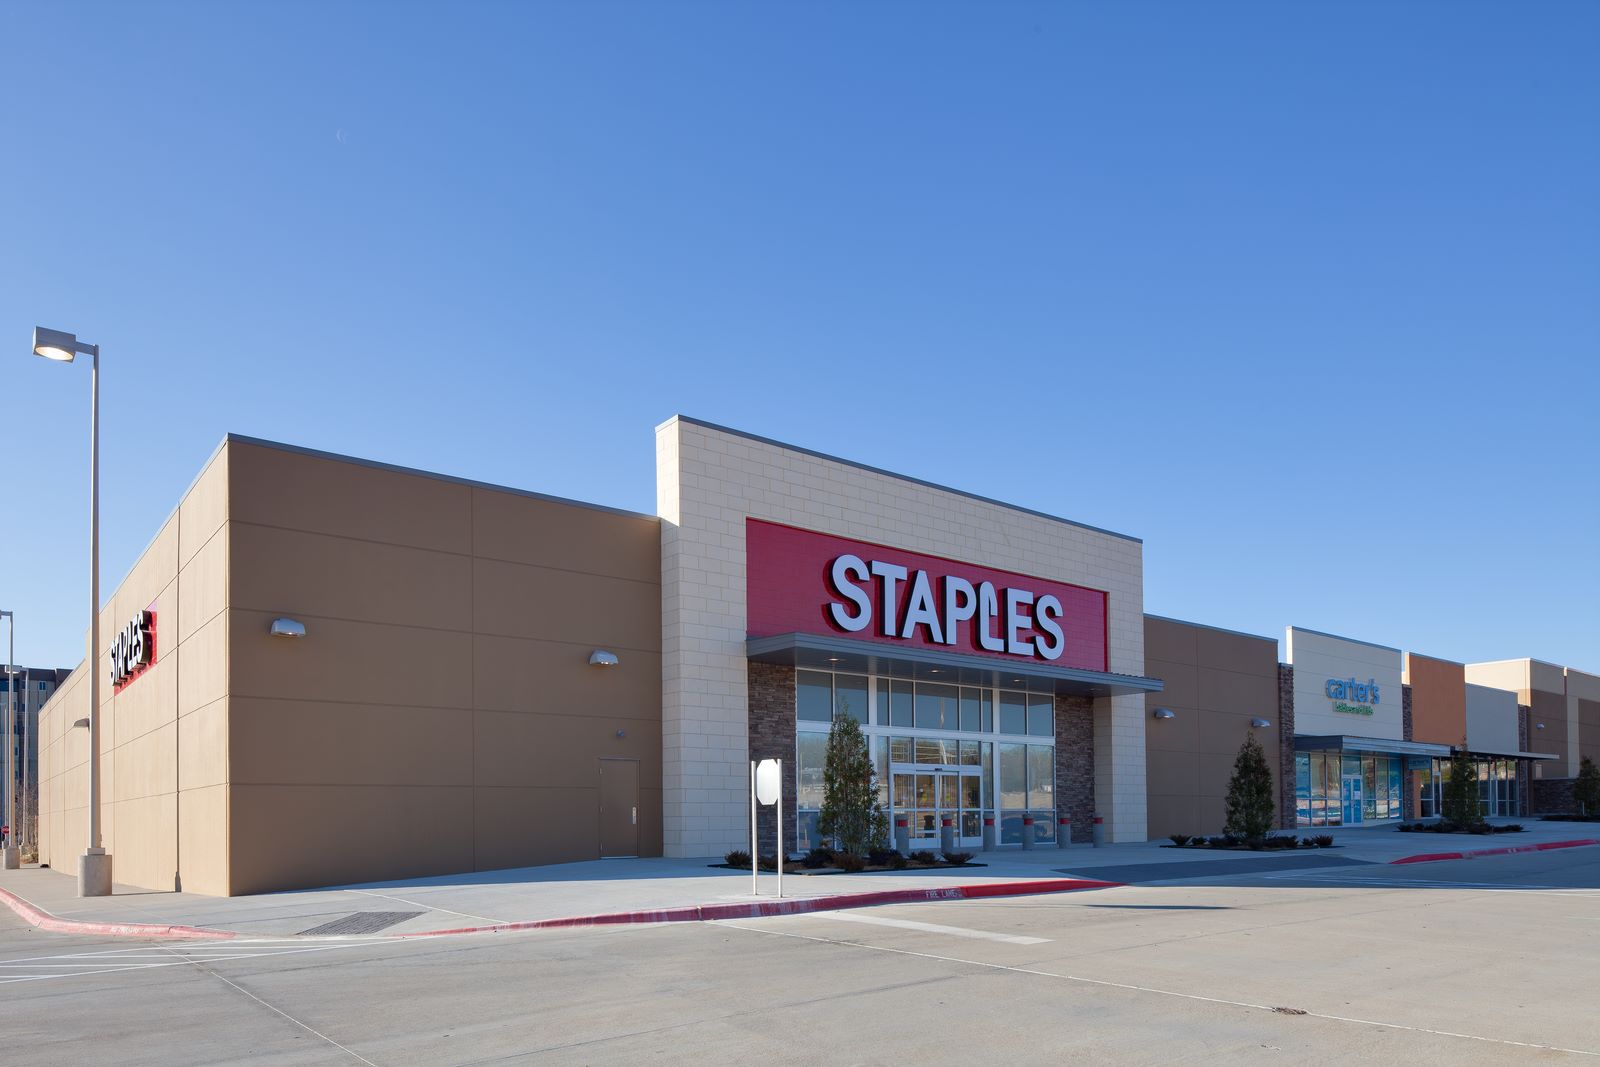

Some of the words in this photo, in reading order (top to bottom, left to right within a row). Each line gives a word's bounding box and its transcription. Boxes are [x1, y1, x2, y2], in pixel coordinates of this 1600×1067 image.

[829, 553, 1065, 660] STAPLES
[109, 609, 146, 687] STAPLES
[1326, 677, 1380, 705] carter's
